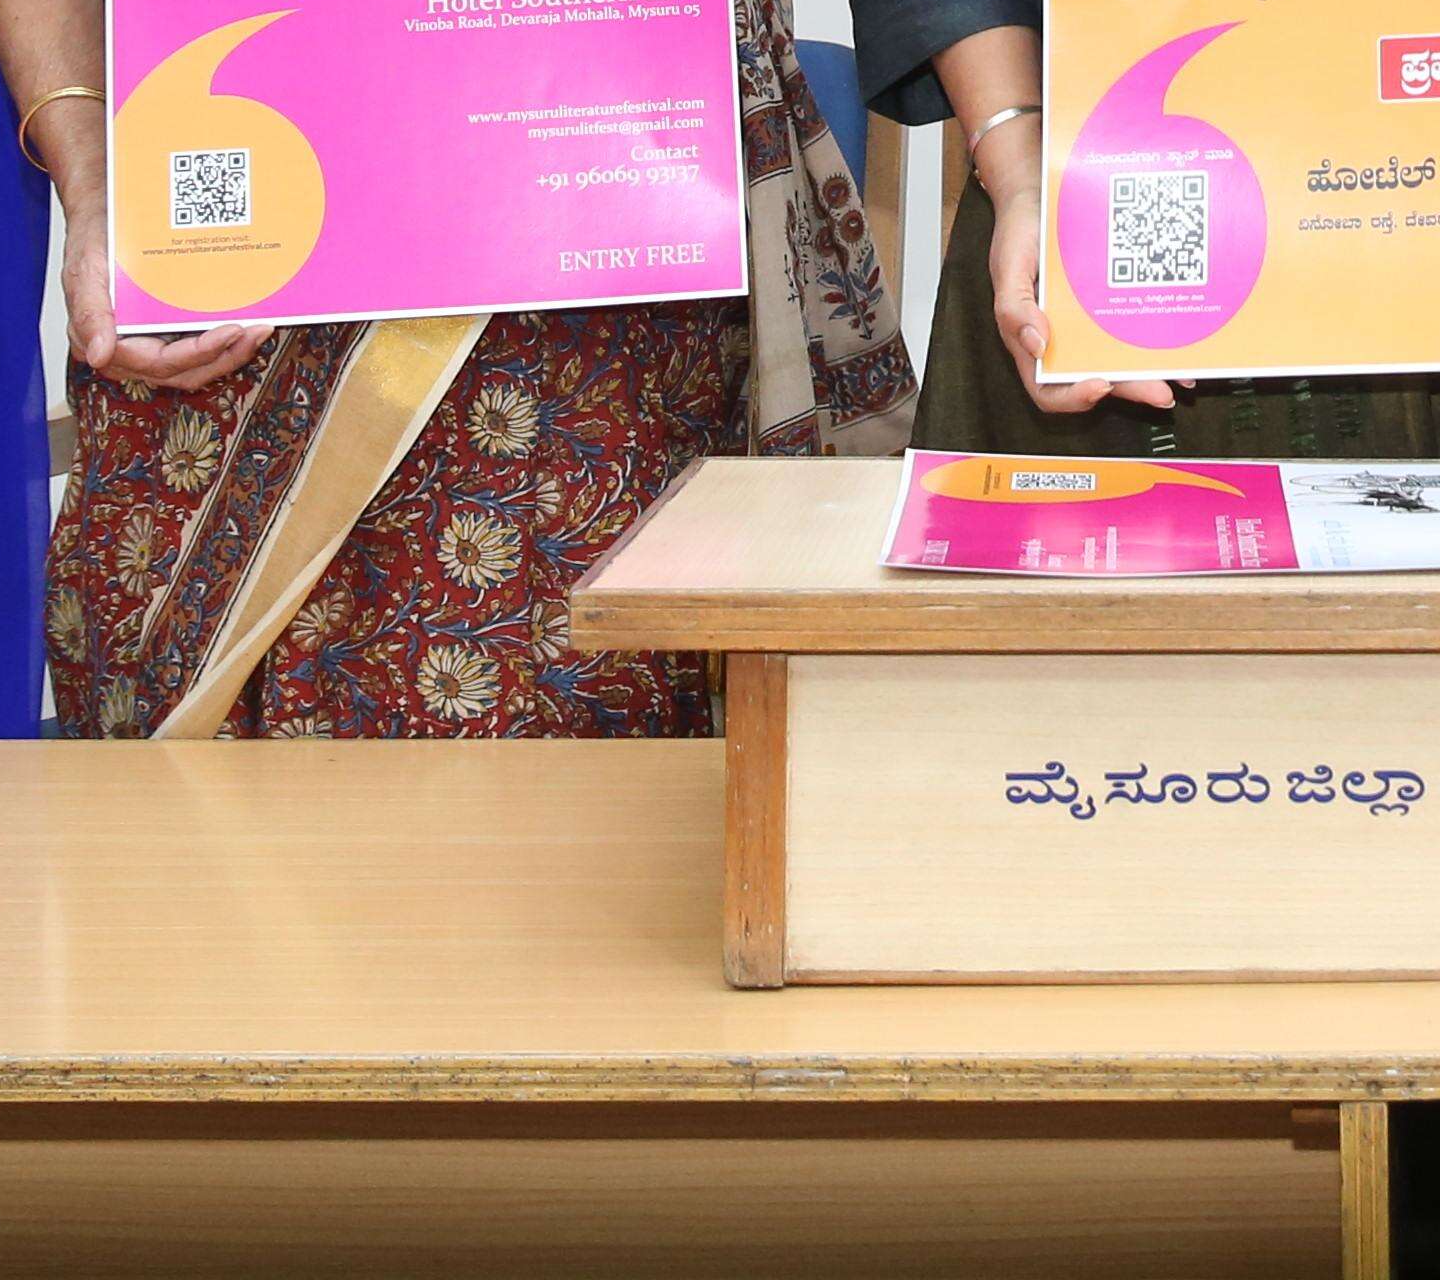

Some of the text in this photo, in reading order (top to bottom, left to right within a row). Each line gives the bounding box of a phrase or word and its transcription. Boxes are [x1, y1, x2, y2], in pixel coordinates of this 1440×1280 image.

[468, 98, 704, 125] www.mysuruliteraturefestival.com
[528, 117, 704, 140] mysurulitfest@gmail.com
[631, 144, 698, 161] Contact
[1308, 156, 1435, 193] ಹೋಟೆಲ್
[561, 243, 705, 272] ENTRY FREE
[1288, 765, 1426, 817] ಜಿಲ್ಲಾ
